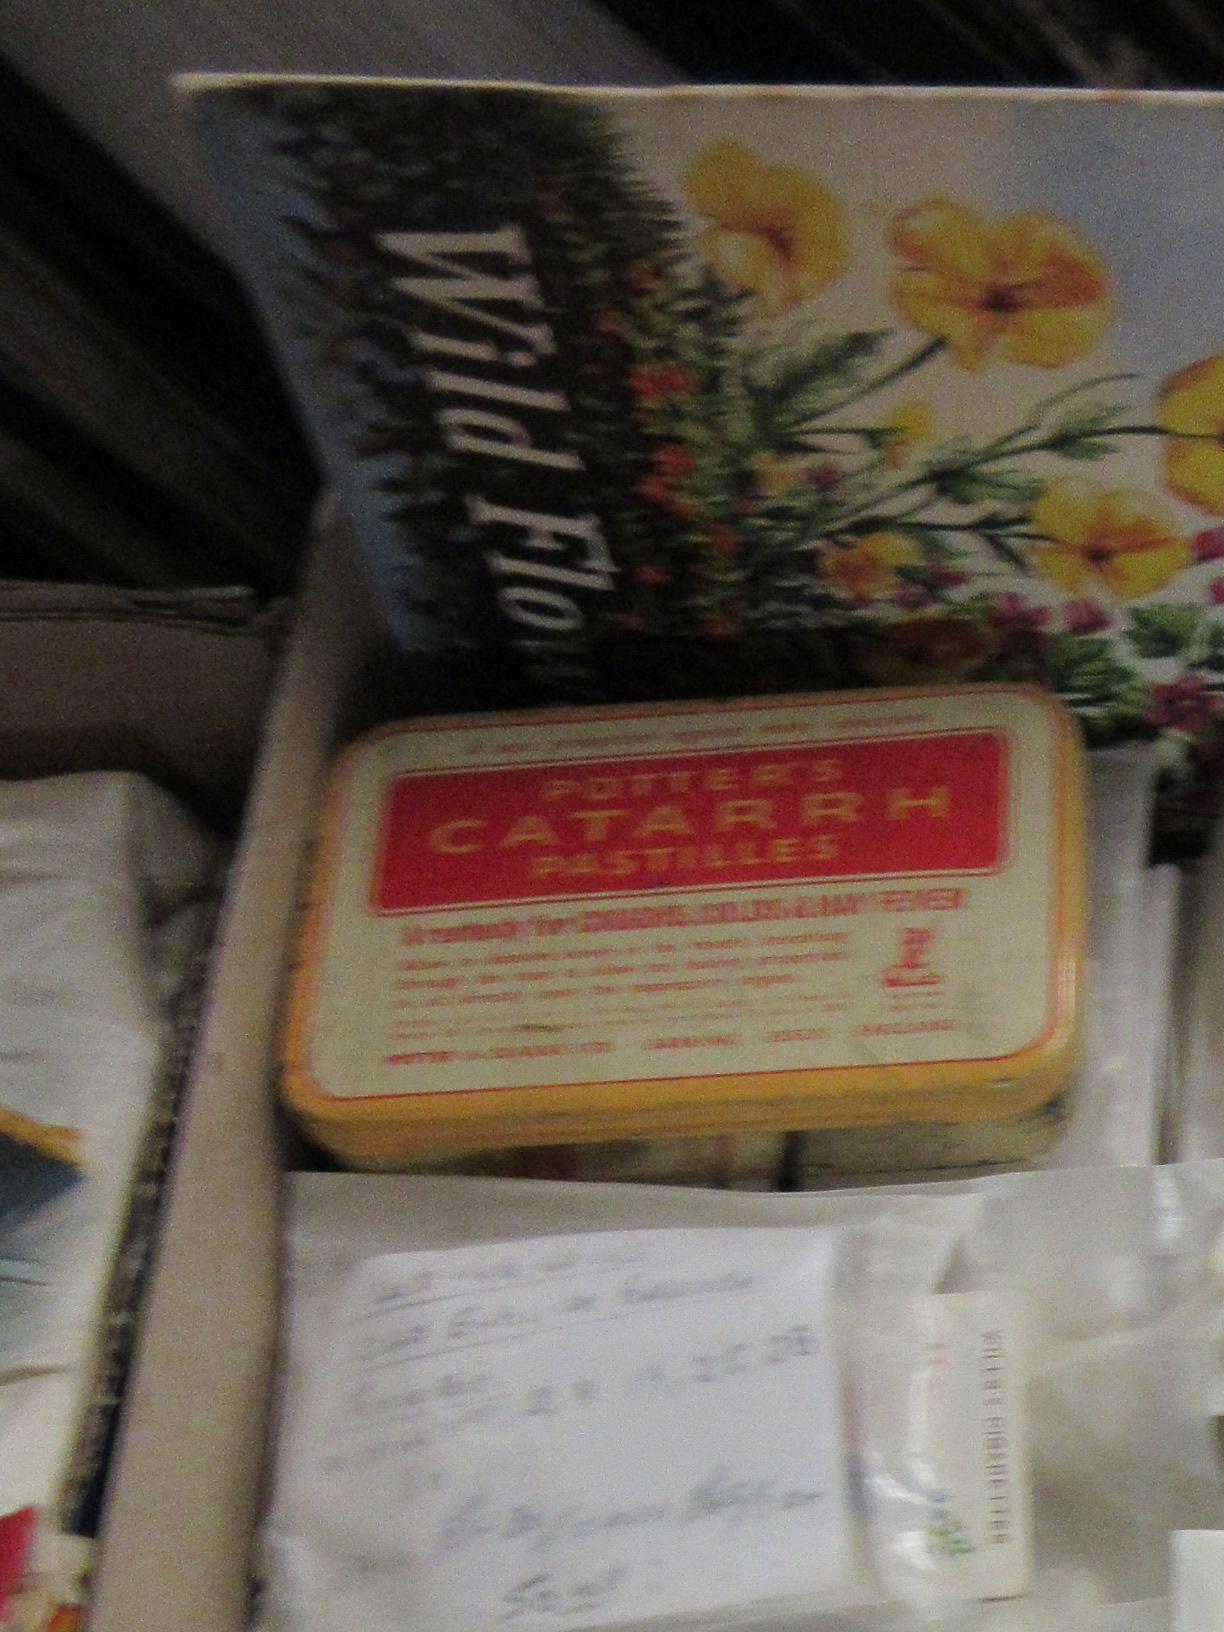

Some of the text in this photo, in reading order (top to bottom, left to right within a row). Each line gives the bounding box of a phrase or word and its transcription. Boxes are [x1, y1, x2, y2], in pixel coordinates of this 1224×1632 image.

[371, 222, 586, 472] Wild
[540, 755, 847, 803] POTTER'S
[428, 784, 954, 857] CATARRH
[527, 834, 842, 881] PASTILLES
